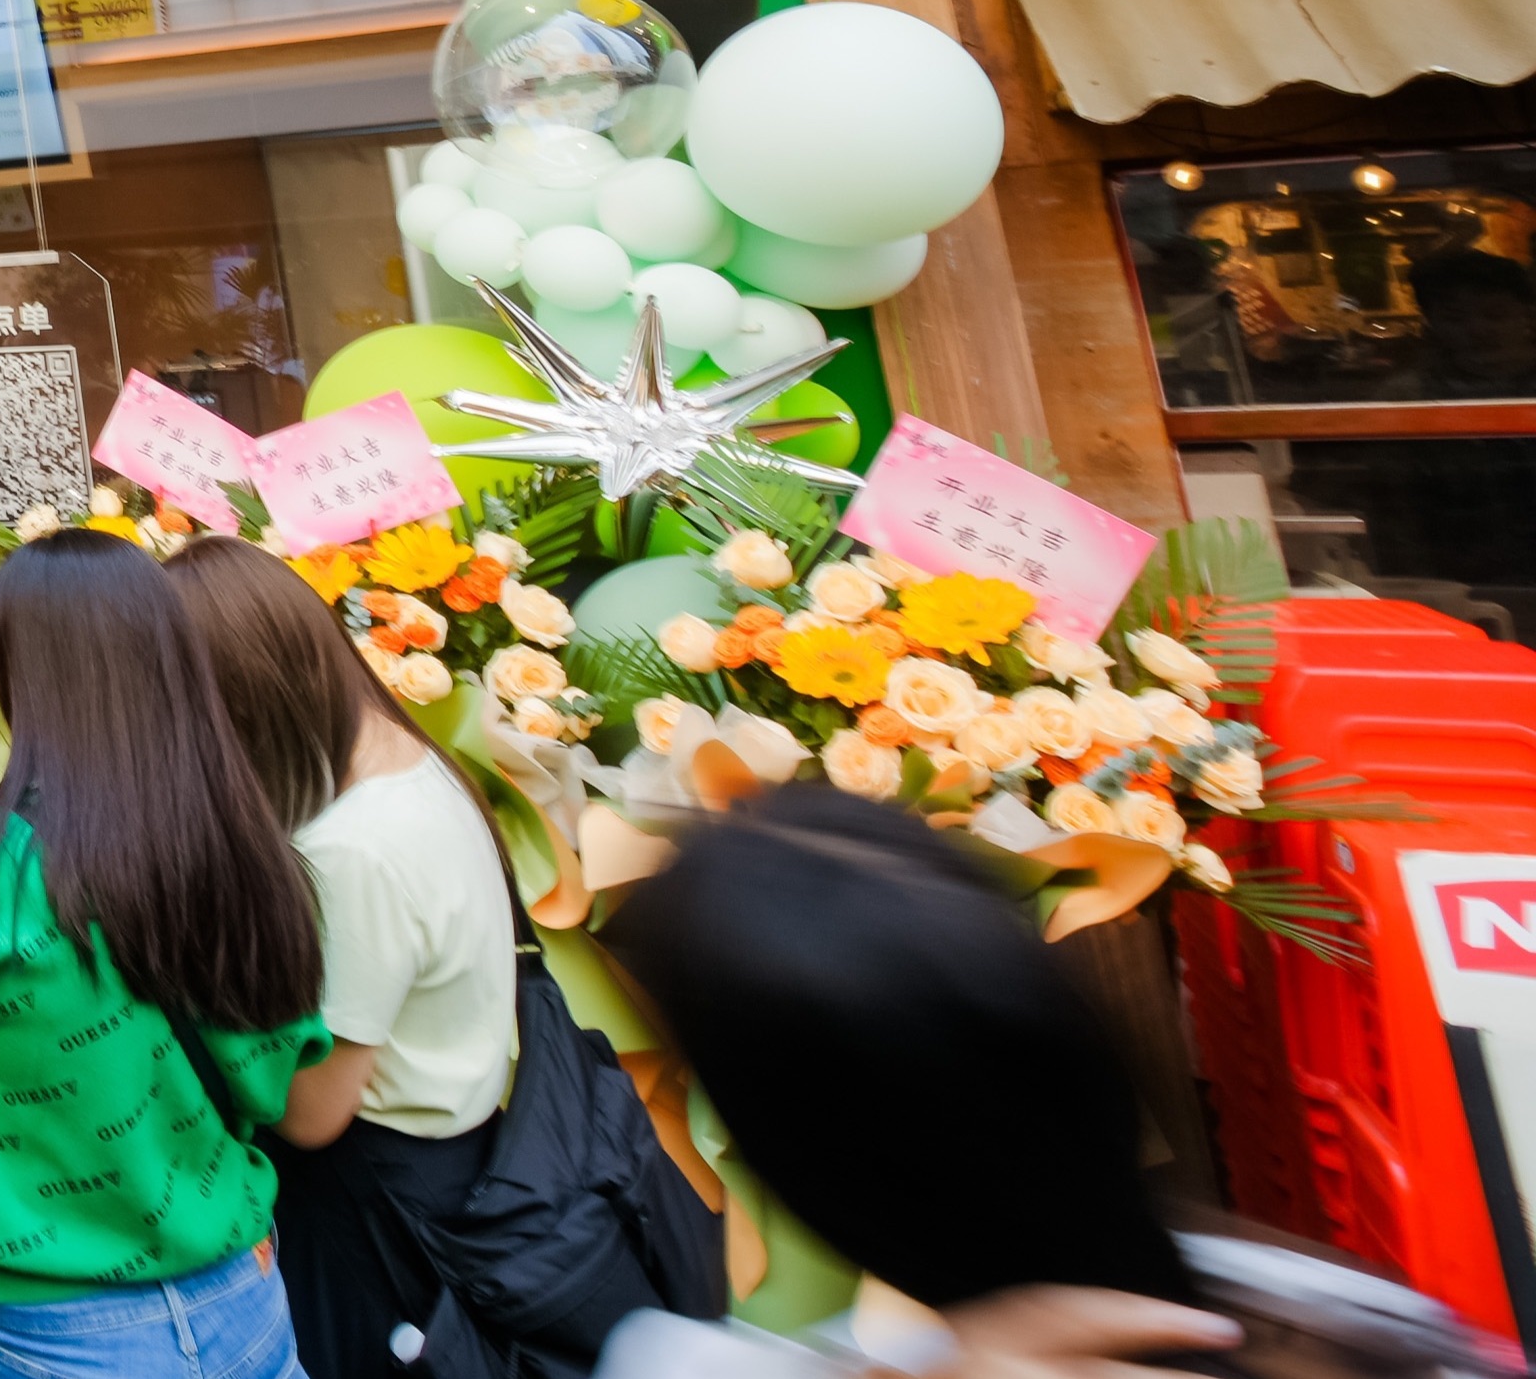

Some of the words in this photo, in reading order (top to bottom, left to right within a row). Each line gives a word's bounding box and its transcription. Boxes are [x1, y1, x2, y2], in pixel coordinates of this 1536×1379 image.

[148, 412, 228, 468] 开业大吉
[293, 434, 384, 483] 开业大吉
[136, 438, 215, 494] 生意兴隆
[311, 467, 403, 516] 生意兴隆
[933, 474, 1072, 553] 开业大吉
[911, 508, 1051, 588] 生意兴隆
[58, 1015, 122, 1054] GUESS
[1, 1083, 63, 1108] GUESS
[37, 1174, 106, 1200] GUESS
